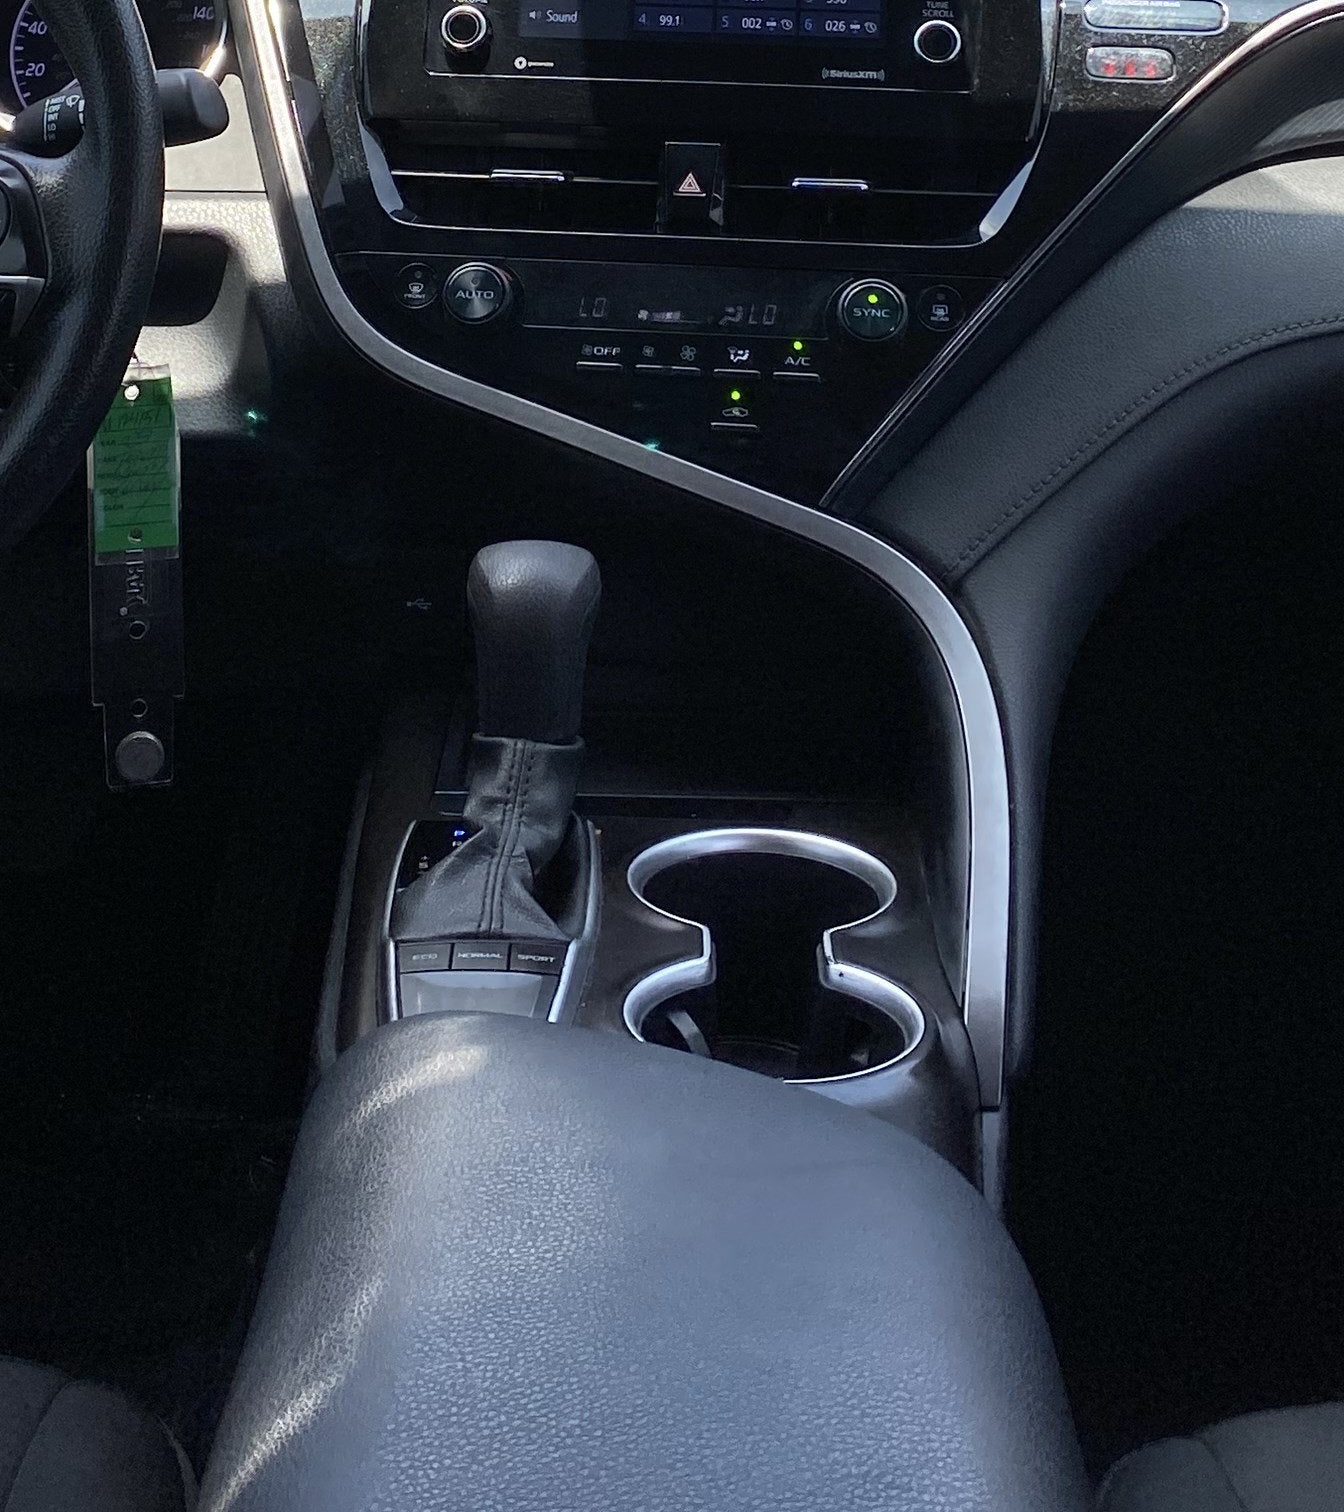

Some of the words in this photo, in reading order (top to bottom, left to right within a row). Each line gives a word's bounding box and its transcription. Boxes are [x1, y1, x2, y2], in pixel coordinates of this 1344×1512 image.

[545, 9, 578, 23] Sound
[922, 9, 954, 18] SCROLL
[659, 15, 680, 27] 99.1
[741, 18, 762, 29] 002
[825, 20, 846, 32] 026
[28, 21, 48, 35] 40
[25, 63, 45, 77] 20
[456, 289, 494, 299] AUTO
[852, 308, 891, 318] SYNC
[593, 346, 621, 356] OFF
[784, 356, 811, 366] A/C
[412, 954, 438, 962] ECO
[456, 952, 503, 961] NORMAL
[517, 954, 556, 963] SPORT
